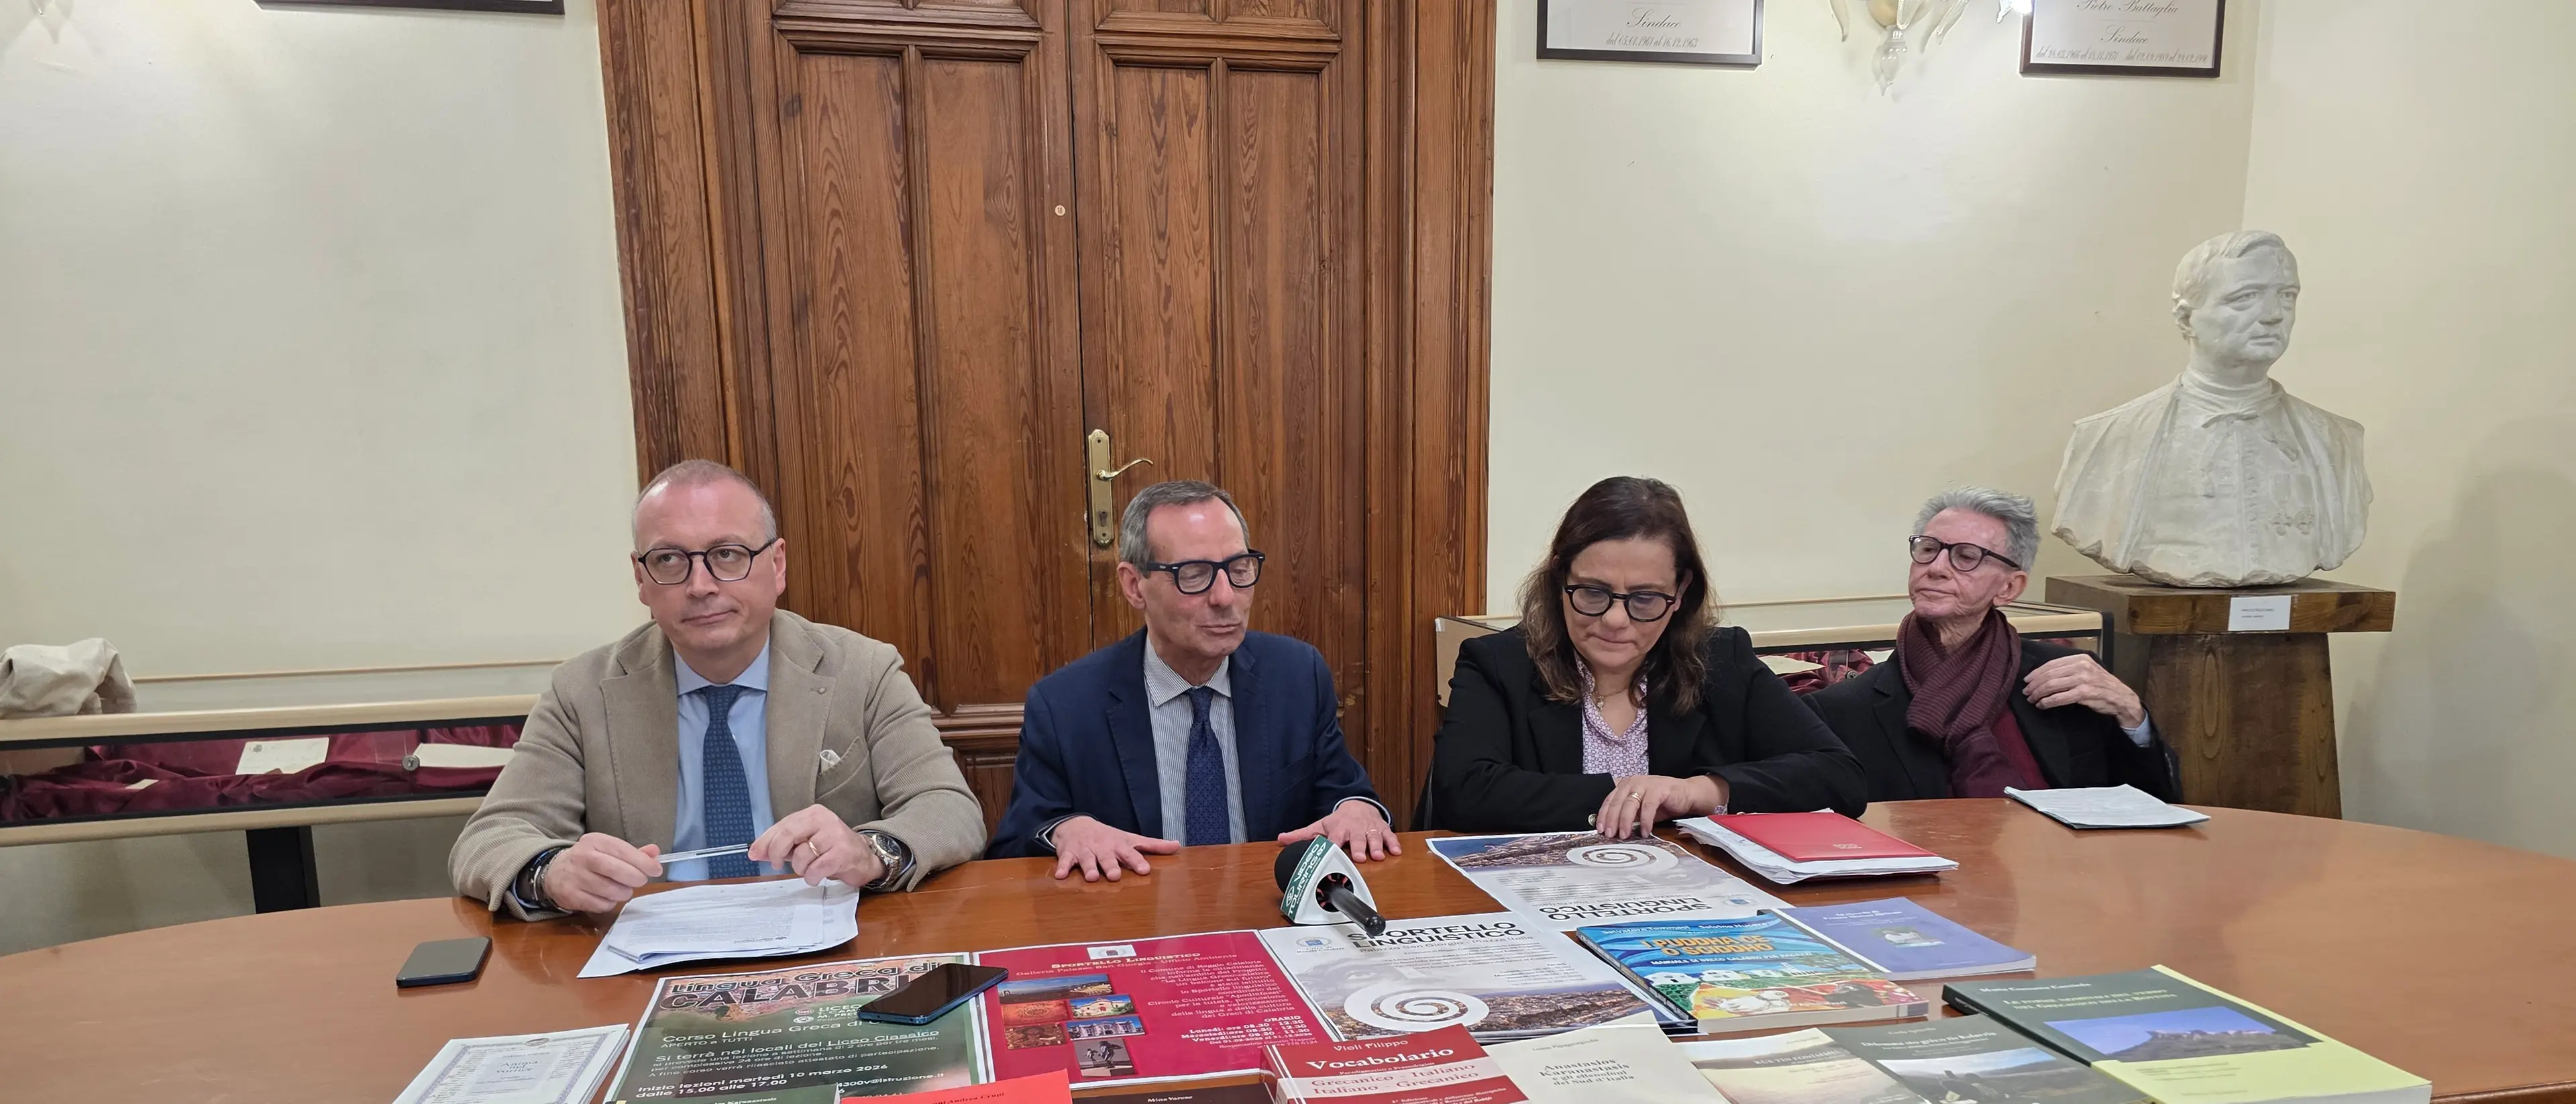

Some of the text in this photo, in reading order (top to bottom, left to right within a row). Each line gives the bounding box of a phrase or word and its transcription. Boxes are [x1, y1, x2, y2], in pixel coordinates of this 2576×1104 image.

[1627, 7, 1680, 28] Sindaco
[2100, 24, 2149, 44] Sindaco
[1540, 897, 1703, 913] LINGUISTICO
[1548, 903, 1712, 920] SPORTELLO
[1352, 929, 1525, 948] LINGUISTICO
[1052, 953, 1201, 968] SPORTELLO LINGUISTICO
[671, 962, 938, 993] Lingua Greca di
[660, 974, 911, 1009] CALABRI
[819, 1004, 862, 1012] LICEO
[722, 1028, 782, 1038] Lingua
[789, 1023, 841, 1032] Greca
[677, 1052, 714, 1060] terrà
[751, 1044, 792, 1053] locali
[875, 1031, 939, 1040] Classico
[1365, 1039, 1408, 1050] Filippo
[665, 1058, 706, 1066] prevede
[671, 1060, 735, 1070] complessive
[747, 1060, 794, 1068] rilasciato
[798, 1055, 845, 1063] attestato
[861, 1047, 939, 1058] partecipazione.
[1306, 1049, 1454, 1070] Vocabolario
[1544, 1059, 1616, 1070] Anastasios
[1311, 1064, 1474, 1087] Grecanico Italiano
[1539, 1064, 1630, 1076] Karanastasis
[680, 1080, 725, 1089] lezioni
[730, 1074, 784, 1084] martedì
[1313, 1072, 1479, 1095] Italiano Grecanico
